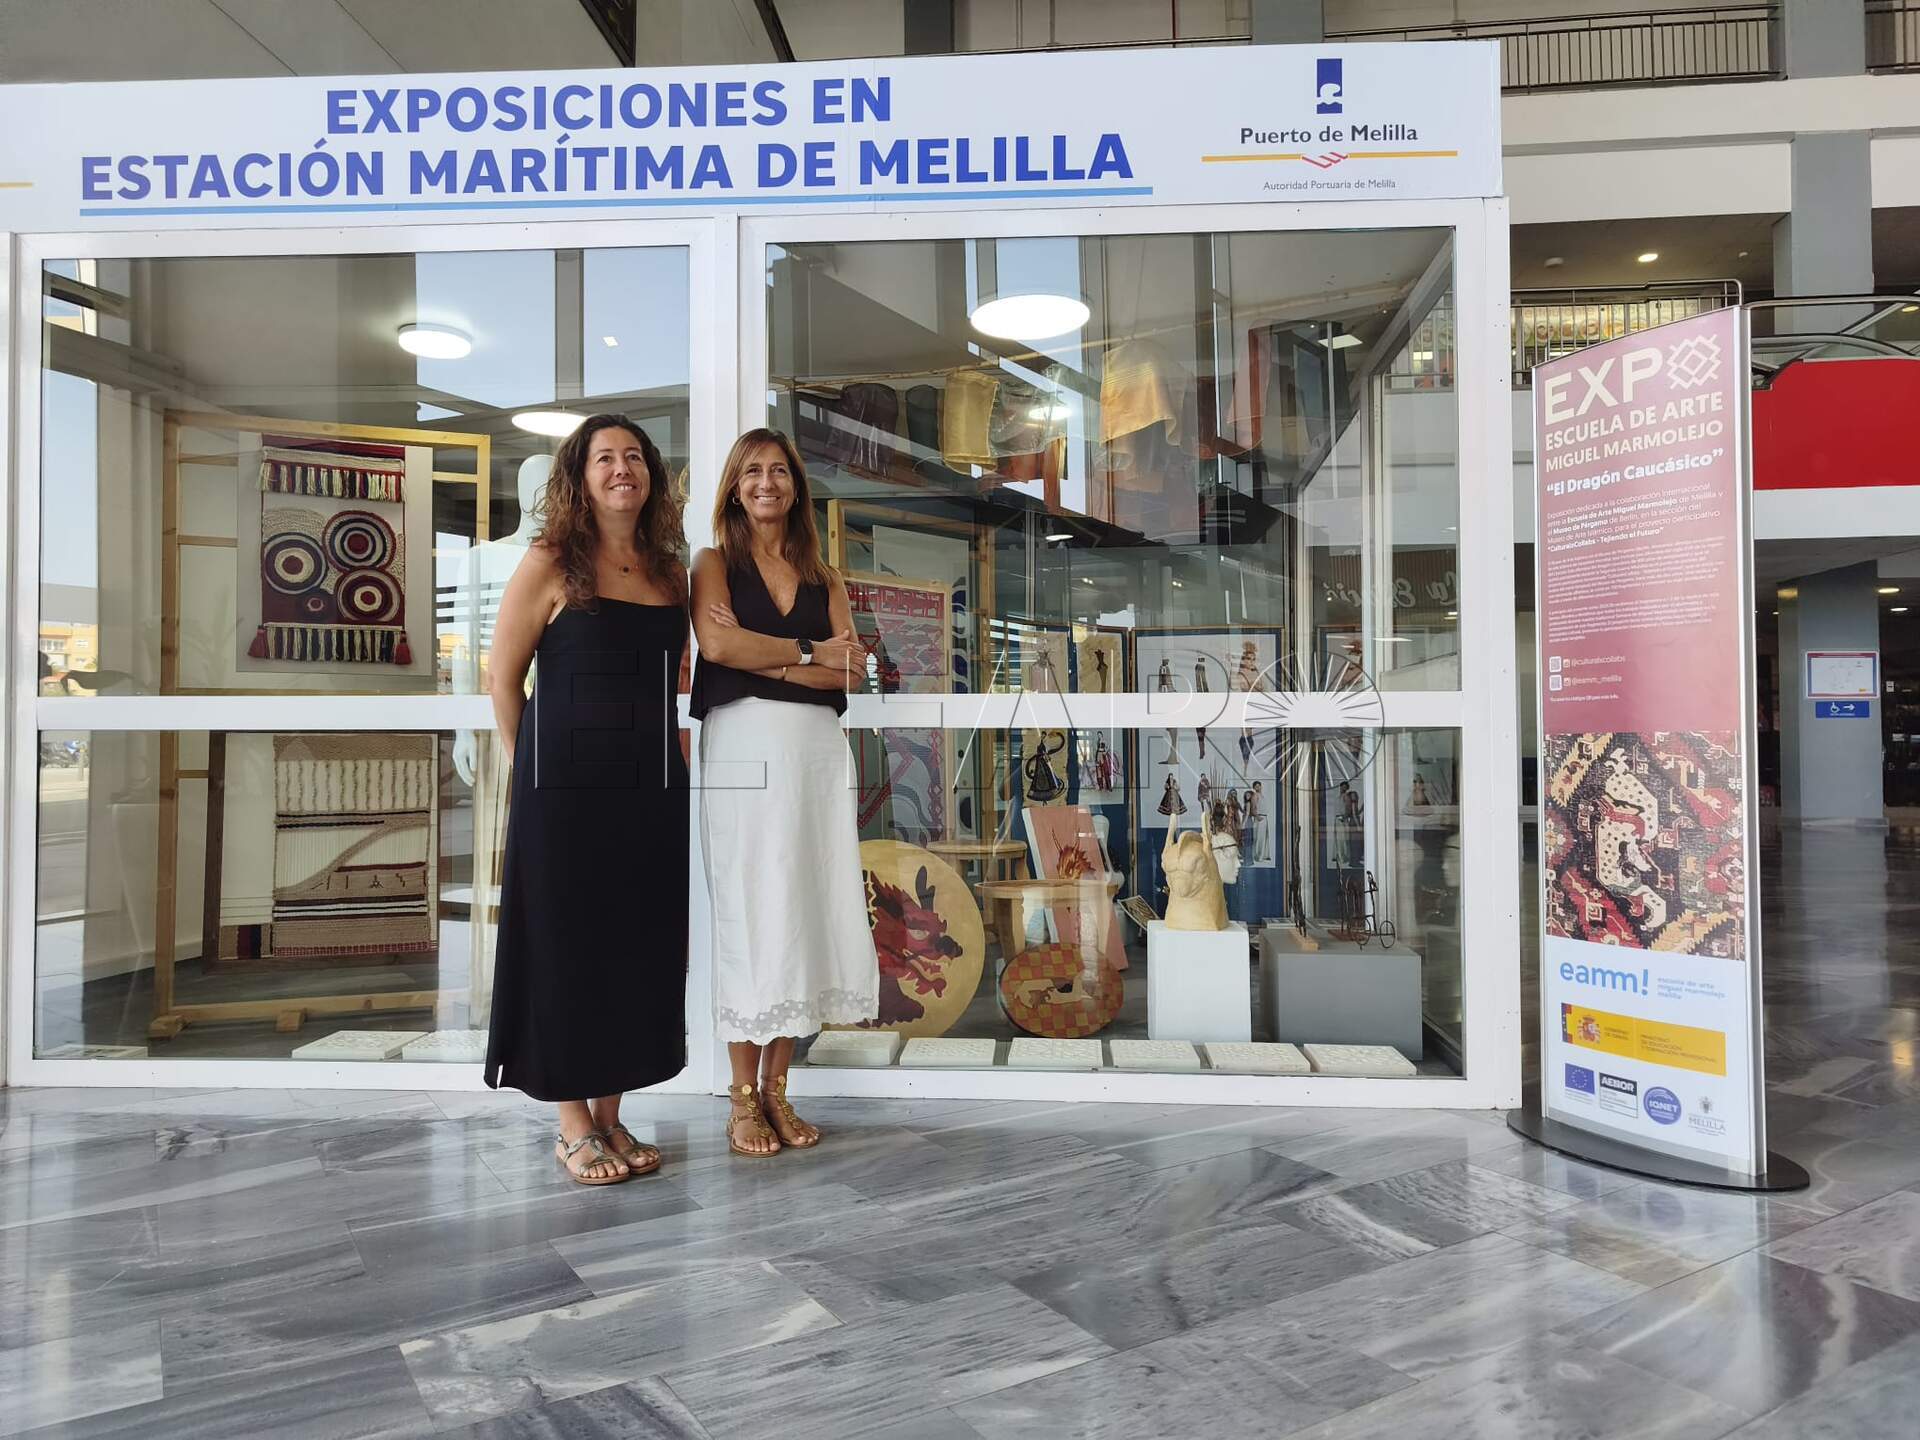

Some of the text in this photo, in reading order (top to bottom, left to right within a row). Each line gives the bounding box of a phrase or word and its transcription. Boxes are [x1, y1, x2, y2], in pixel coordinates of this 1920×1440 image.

[327, 77, 891, 134] EXPOSICIONES EN
[1240, 124, 1418, 145] Puerto de Melilla
[82, 133, 1134, 200] ESTACIÓN MARÍTIMA DE MELILLA
[1263, 179, 1396, 191] Autoridad Portuaria de Melilla
[1545, 391, 1723, 451] ESCUELA DE ARTE
[1546, 420, 1723, 473] MIGUEL MARMOLEJO
[1547, 447, 1724, 496] “El Dragón Caucásico”
[1567, 513, 1588, 525] Escuela
[1598, 508, 1612, 518] Arte
[1613, 504, 1637, 516] Miguel
[1637, 497, 1677, 511] Marmolejo
[1600, 533, 1629, 545] Tejiendo
[1559, 961, 1649, 996] eamm!
